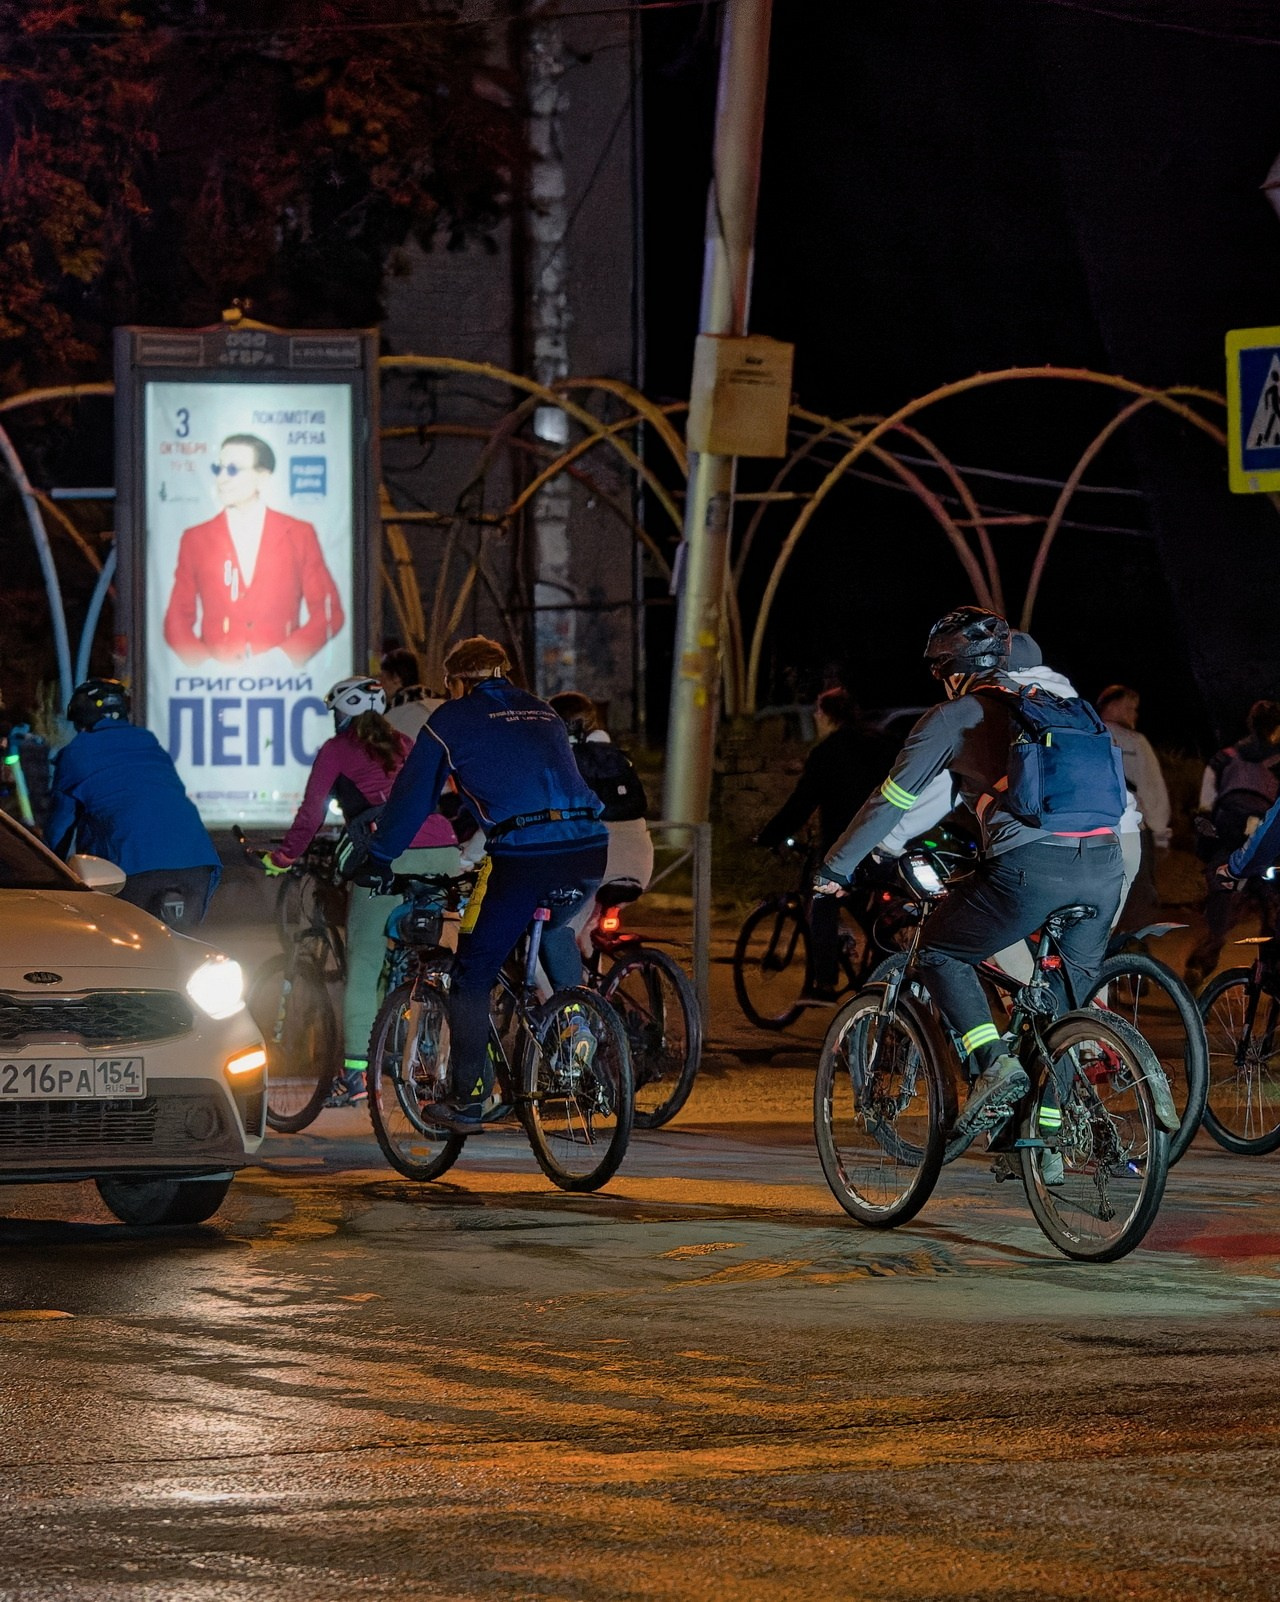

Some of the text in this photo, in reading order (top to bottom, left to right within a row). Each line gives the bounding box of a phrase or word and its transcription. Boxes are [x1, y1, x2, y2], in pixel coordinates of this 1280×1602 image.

[176, 408, 190, 437] 3
[287, 431, 326, 444] АРЕНА
[175, 673, 313, 692] ГРИГОРИЙ
[168, 696, 329, 767] ЛЕПС
[97, 1061, 137, 1084] 154
[105, 1084, 125, 1092] RUS
